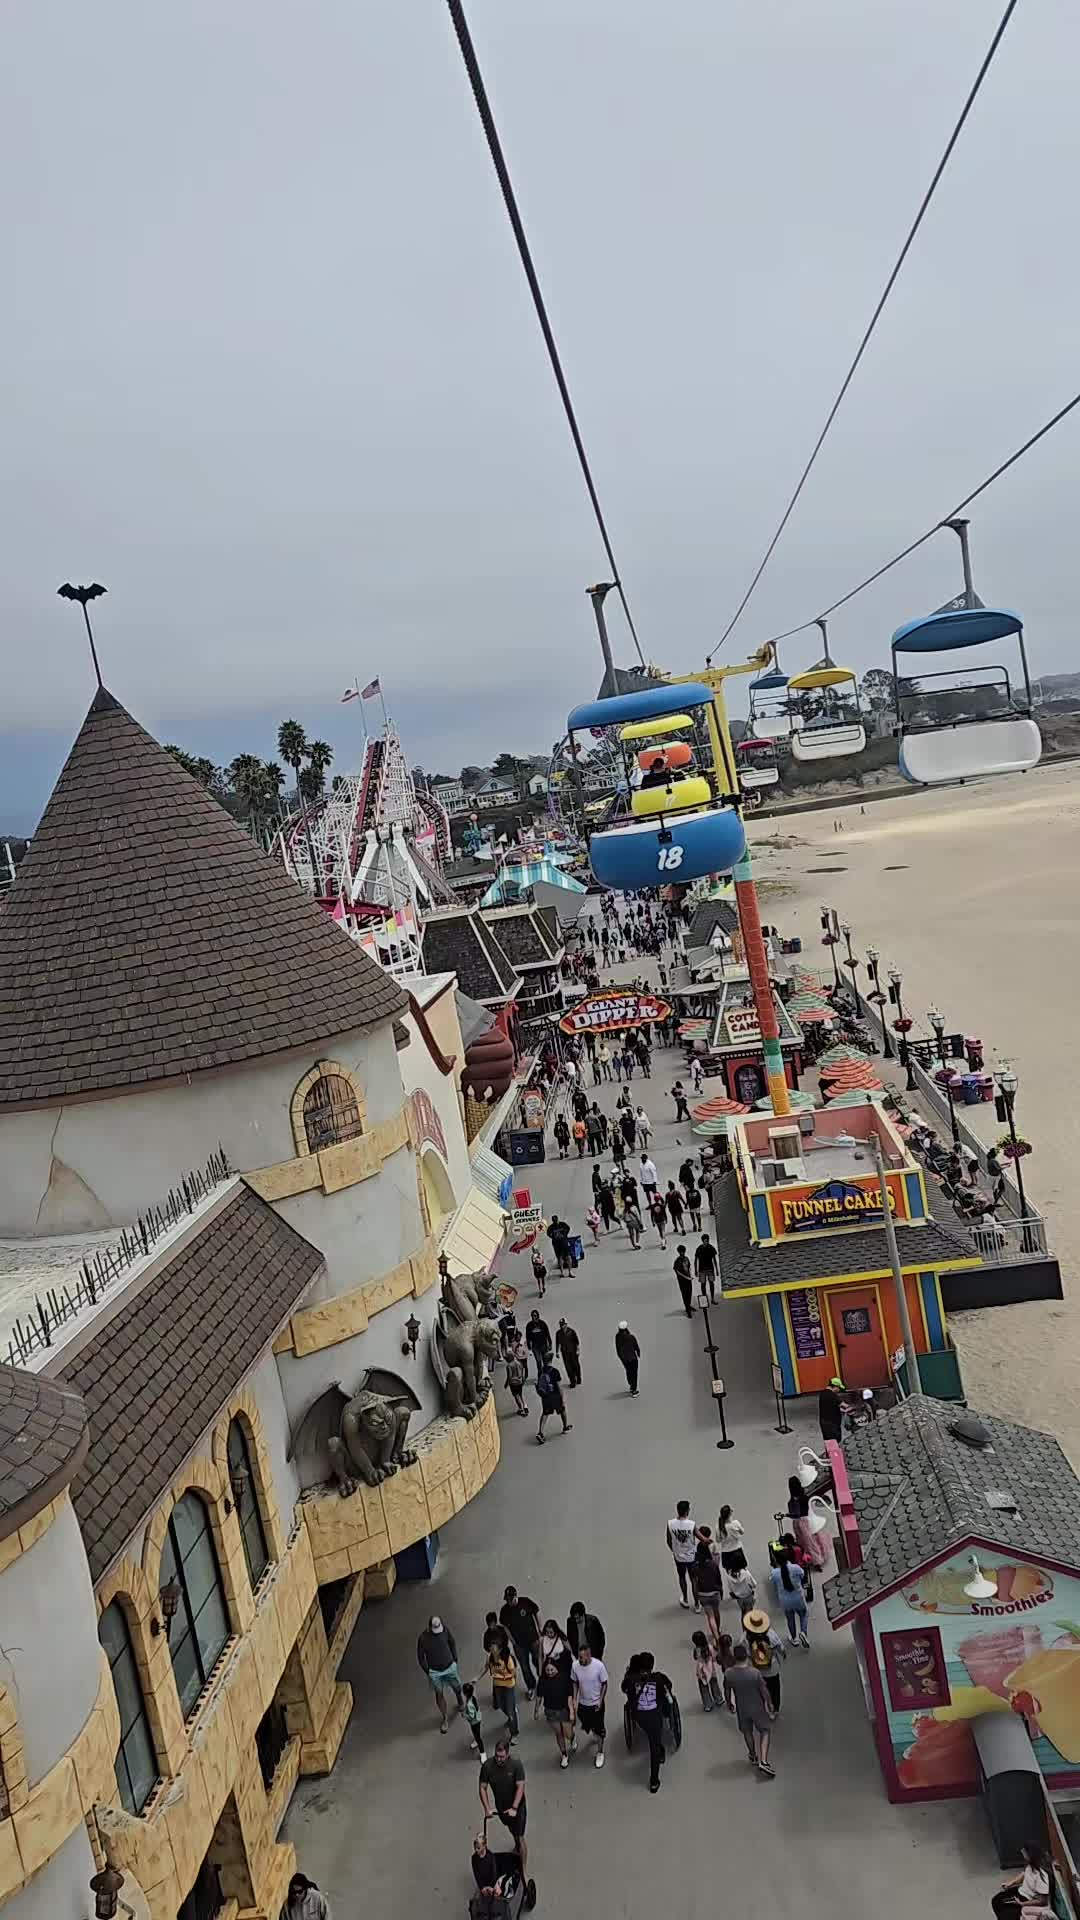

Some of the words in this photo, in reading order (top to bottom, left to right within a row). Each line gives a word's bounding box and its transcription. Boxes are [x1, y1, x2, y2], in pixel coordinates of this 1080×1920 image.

[952, 599, 966, 609] 39
[657, 845, 684, 871] 18
[586, 996, 638, 1012] GIANT
[572, 1006, 658, 1029] DIPPER
[728, 1012, 760, 1023] COTT
[731, 1021, 760, 1032] CAND
[514, 1208, 540, 1218] GUEST
[781, 1199, 843, 1225] FUNNEL
[844, 1186, 896, 1211] CAKES
[970, 1590, 1054, 1616] Smoothies
